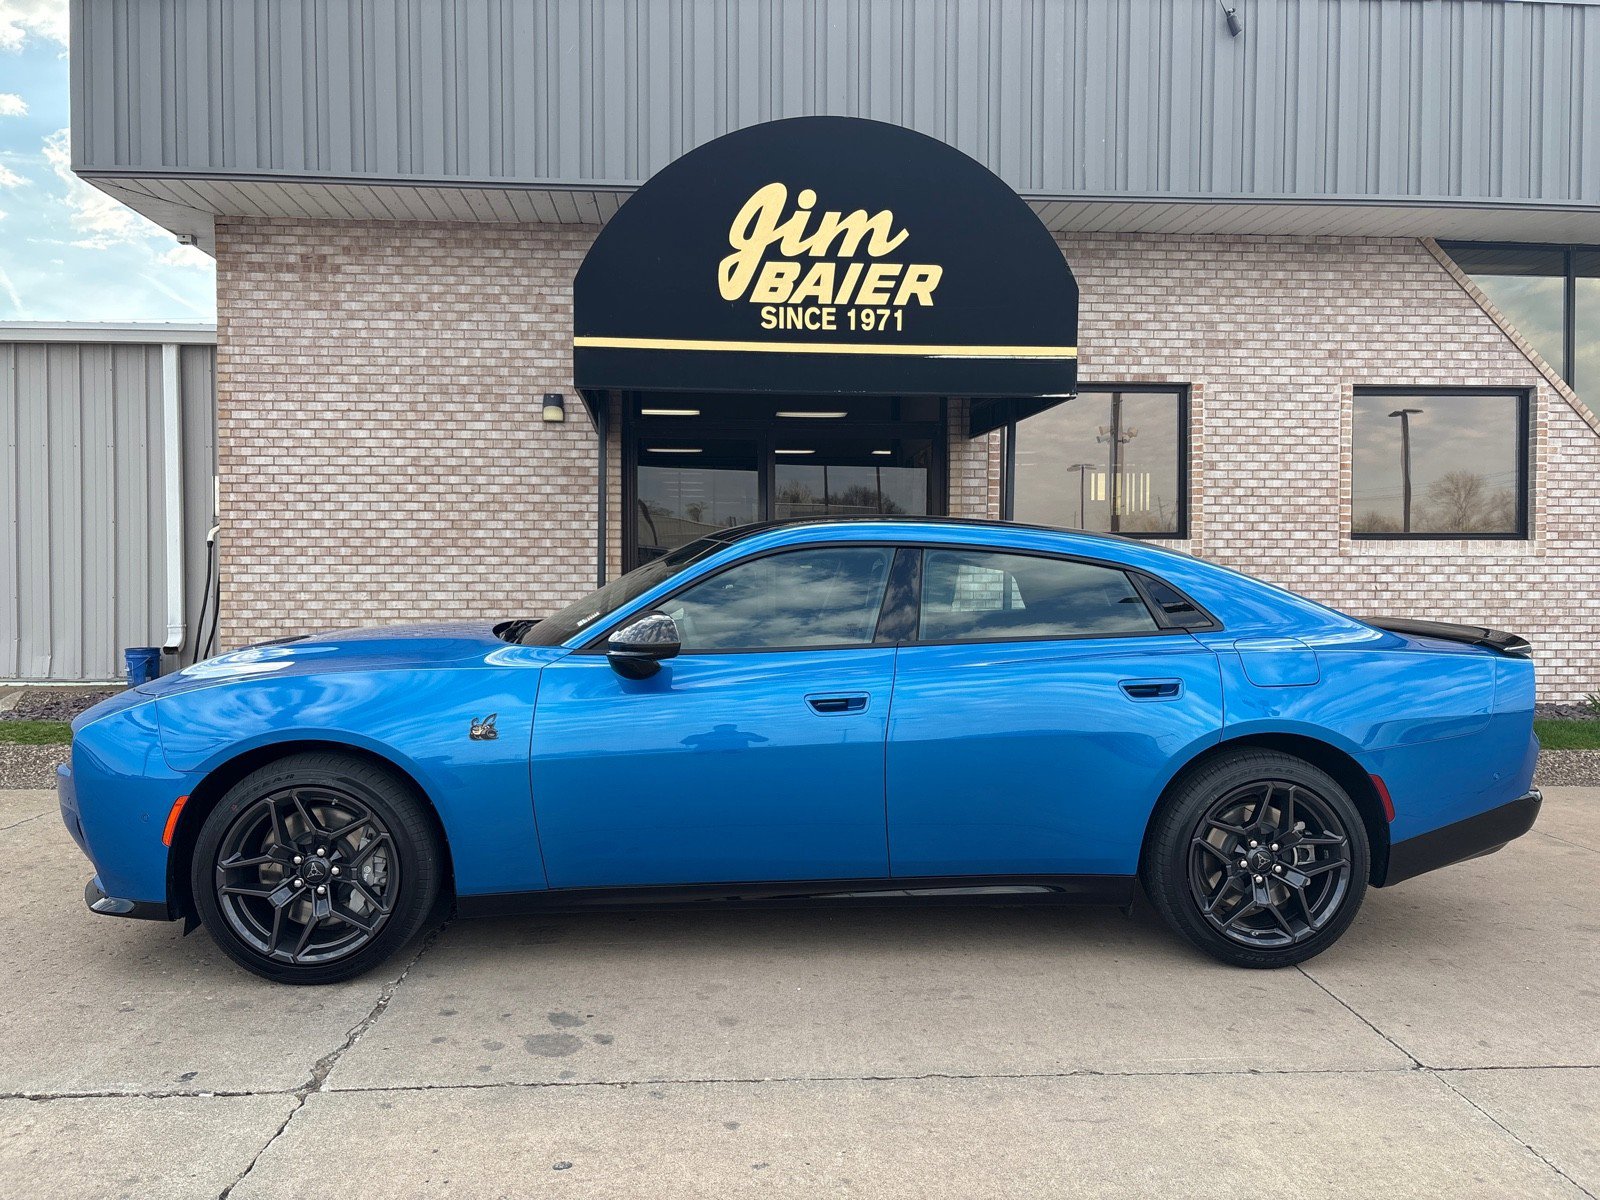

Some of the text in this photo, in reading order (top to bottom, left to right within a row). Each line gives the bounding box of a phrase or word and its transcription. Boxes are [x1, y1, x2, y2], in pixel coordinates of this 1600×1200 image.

[749, 261, 944, 307] BAIER
[760, 305, 904, 332] SINCE 1971
